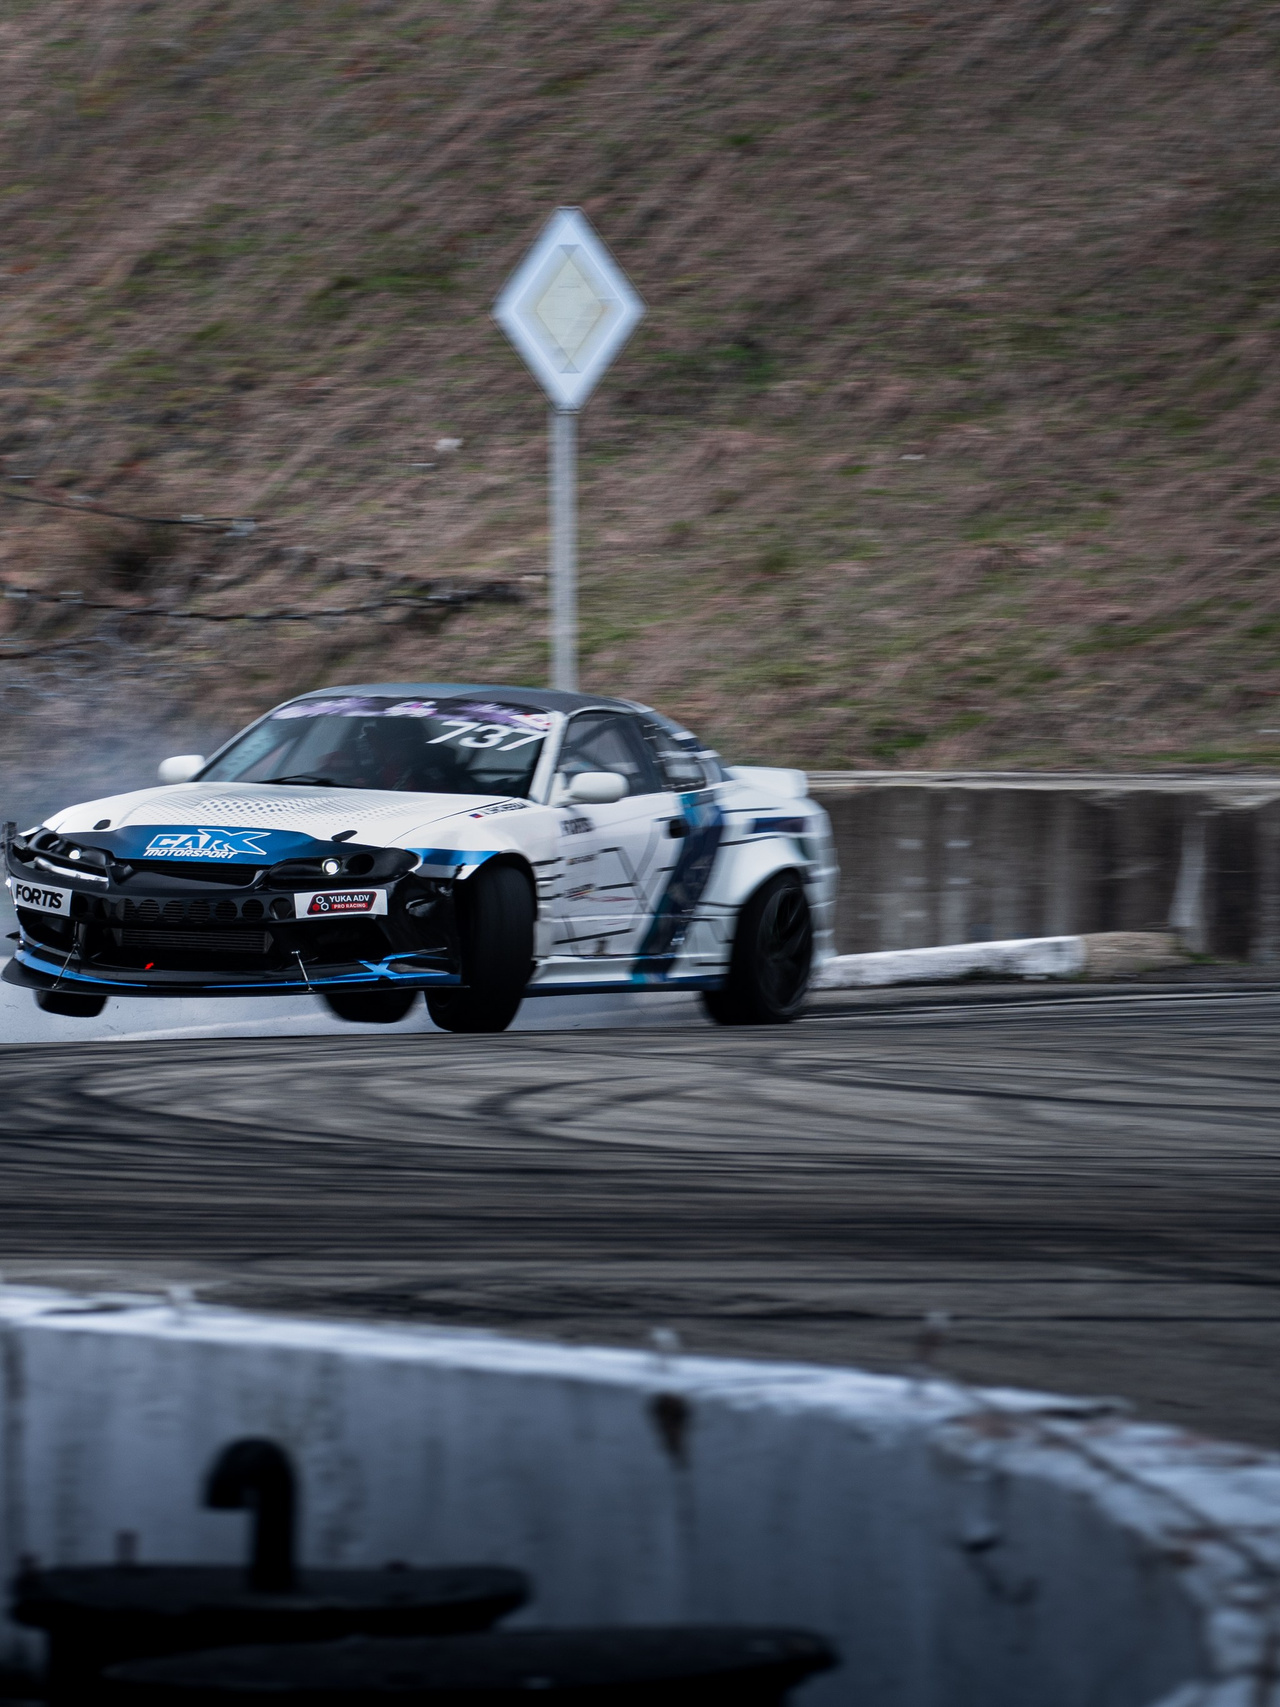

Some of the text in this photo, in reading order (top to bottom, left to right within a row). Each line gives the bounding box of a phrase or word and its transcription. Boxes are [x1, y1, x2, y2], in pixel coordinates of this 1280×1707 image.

[426, 720, 550, 751] 737
[143, 849, 239, 859] MOTORSPORT
[16, 883, 64, 909] FORTIS
[329, 894, 370, 903] YUKA ADV
